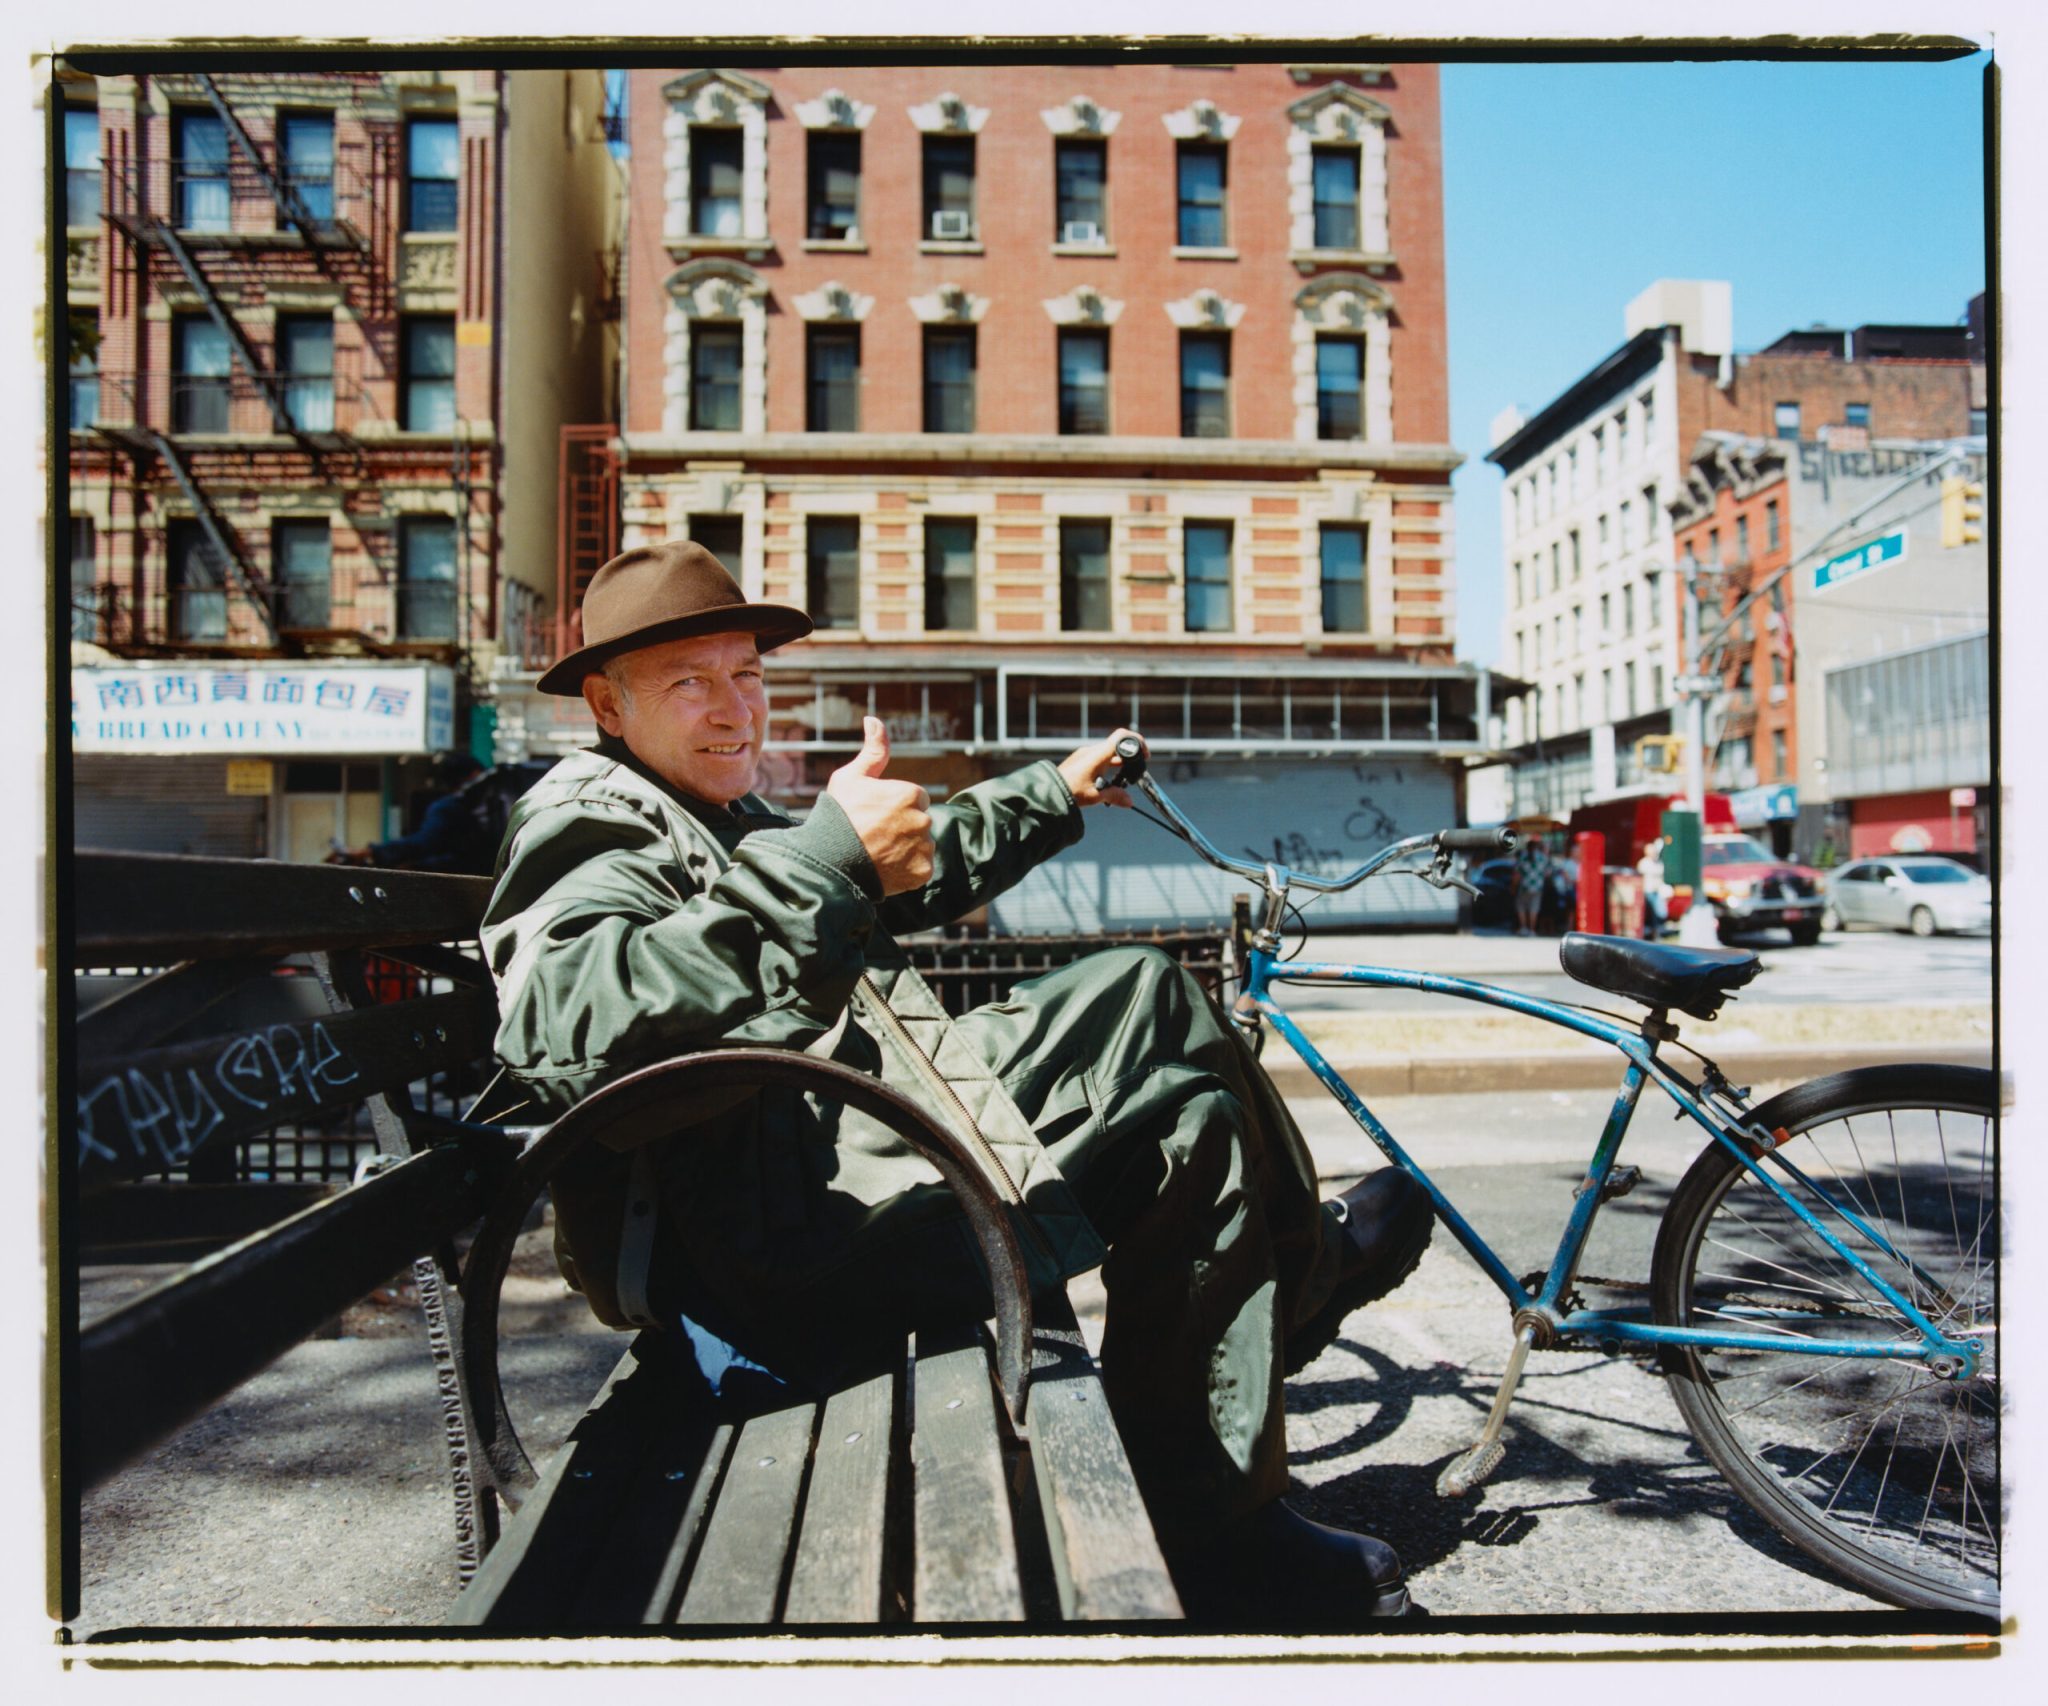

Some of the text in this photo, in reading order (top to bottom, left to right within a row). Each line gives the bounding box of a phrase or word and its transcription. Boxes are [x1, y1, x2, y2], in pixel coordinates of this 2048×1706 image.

[72, 672, 411, 717] 南西貢面包屋
[98, 719, 191, 739] BREAD
[200, 719, 264, 739] CAFE
[413, 1257, 451, 1362] ENNETH
[437, 1367, 467, 1442] LYNCH
